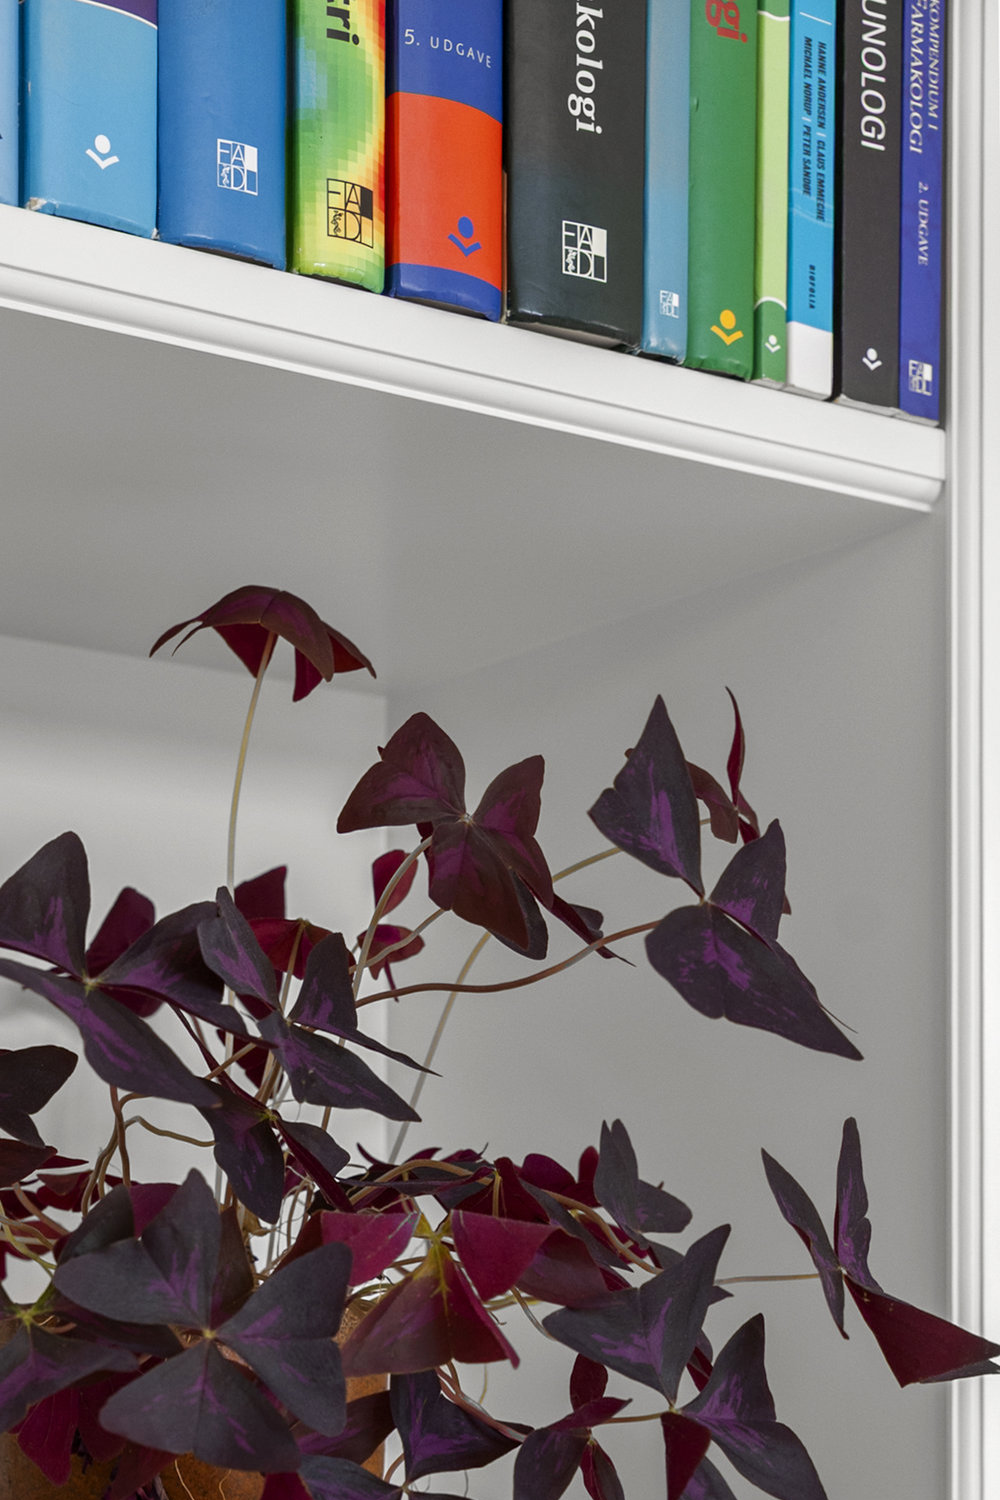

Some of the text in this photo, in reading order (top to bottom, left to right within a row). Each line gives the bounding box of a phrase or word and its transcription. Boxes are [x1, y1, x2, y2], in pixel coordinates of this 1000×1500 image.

[705, 0, 748, 44] gi
[404, 28, 492, 69] 5. UDGAVE
[568, 0, 604, 135] kologi
[803, 36, 813, 79] MICHAEL
[817, 41, 827, 76] HANNE
[803, 82, 812, 116] NORUP
[816, 78, 827, 129] ANDERSEN
[802, 125, 812, 156] PETER
[816, 140, 826, 171] CLAUS
[917, 199, 929, 267] UDGAVE
